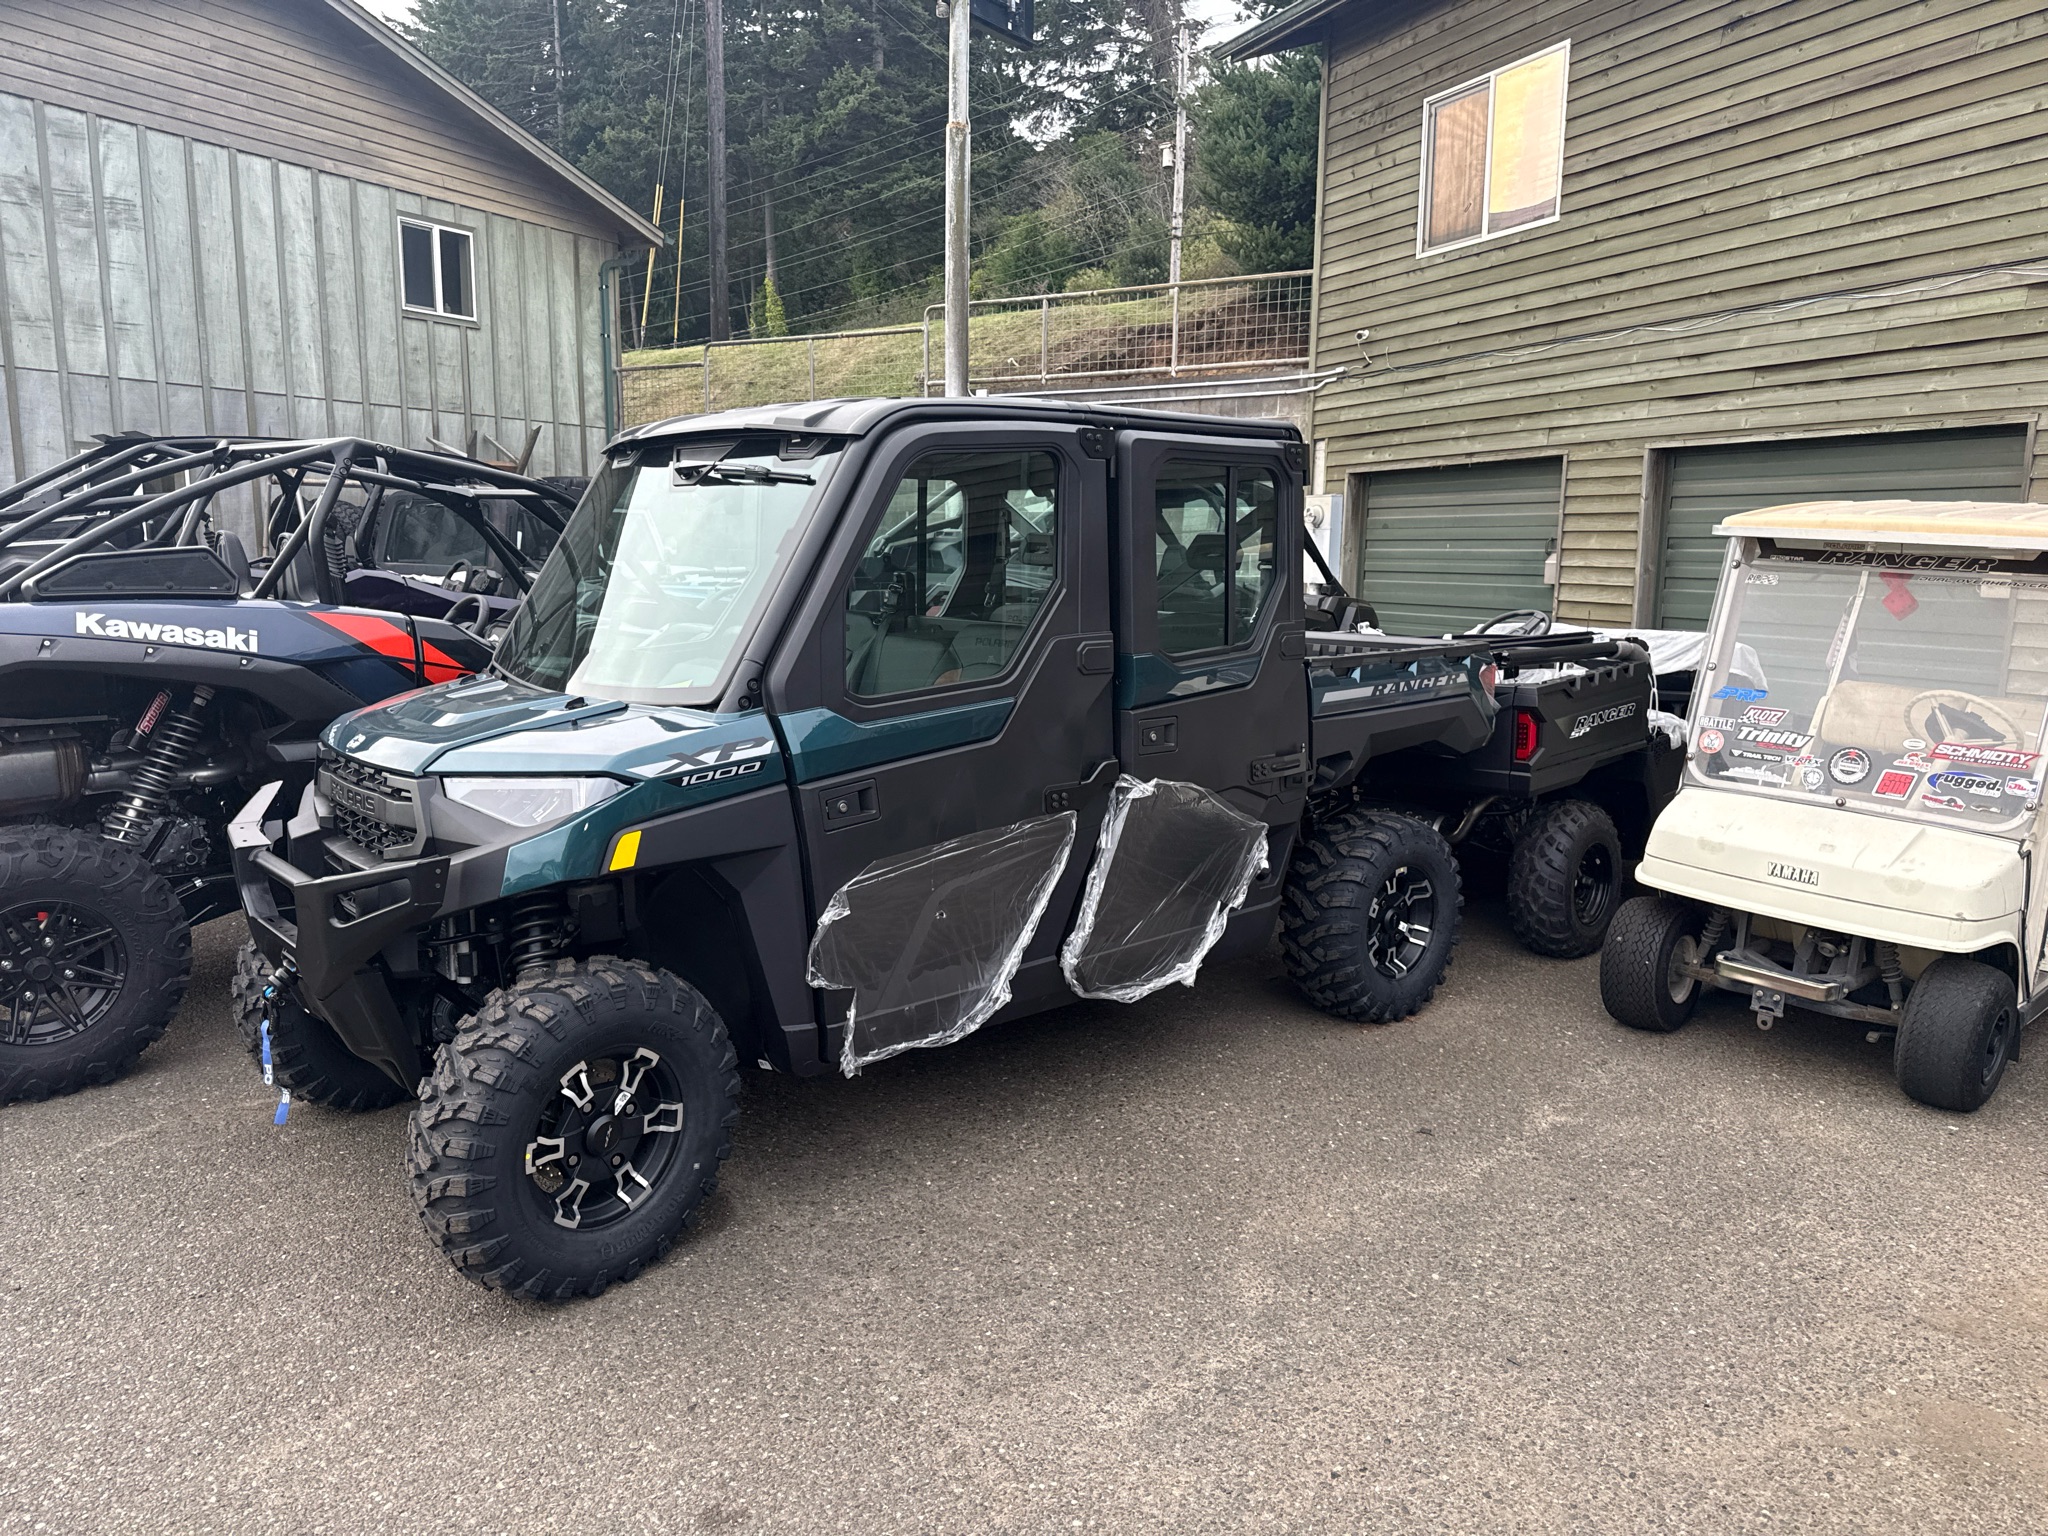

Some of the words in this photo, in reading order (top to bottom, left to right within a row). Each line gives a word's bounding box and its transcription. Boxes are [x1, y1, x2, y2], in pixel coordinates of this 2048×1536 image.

[1823, 542, 1866, 550] POLARIS
[1817, 550, 1999, 574] RANGER
[1955, 578, 2026, 587] OVERHEAD
[75, 612, 258, 652] Kawasaki
[1370, 673, 1460, 697] RANGER
[139, 691, 168, 733] SHOWA
[1573, 702, 1636, 730] RANGER
[1744, 708, 1784, 722] KLOTZ
[1569, 727, 1591, 739] SP
[1737, 727, 1813, 748] Trinity
[654, 736, 770, 775] XP
[1742, 751, 1762, 760] TRAIL
[1763, 753, 1782, 762] TECH
[1786, 756, 1820, 766] VERTEX
[1934, 743, 2035, 765] SCHMIDTY
[681, 761, 761, 786] 1000
[1883, 772, 1913, 783] BIG
[1935, 772, 2001, 792] rugged.
[1877, 780, 1911, 796] GUN
[1767, 861, 1819, 886] YAMAHA
